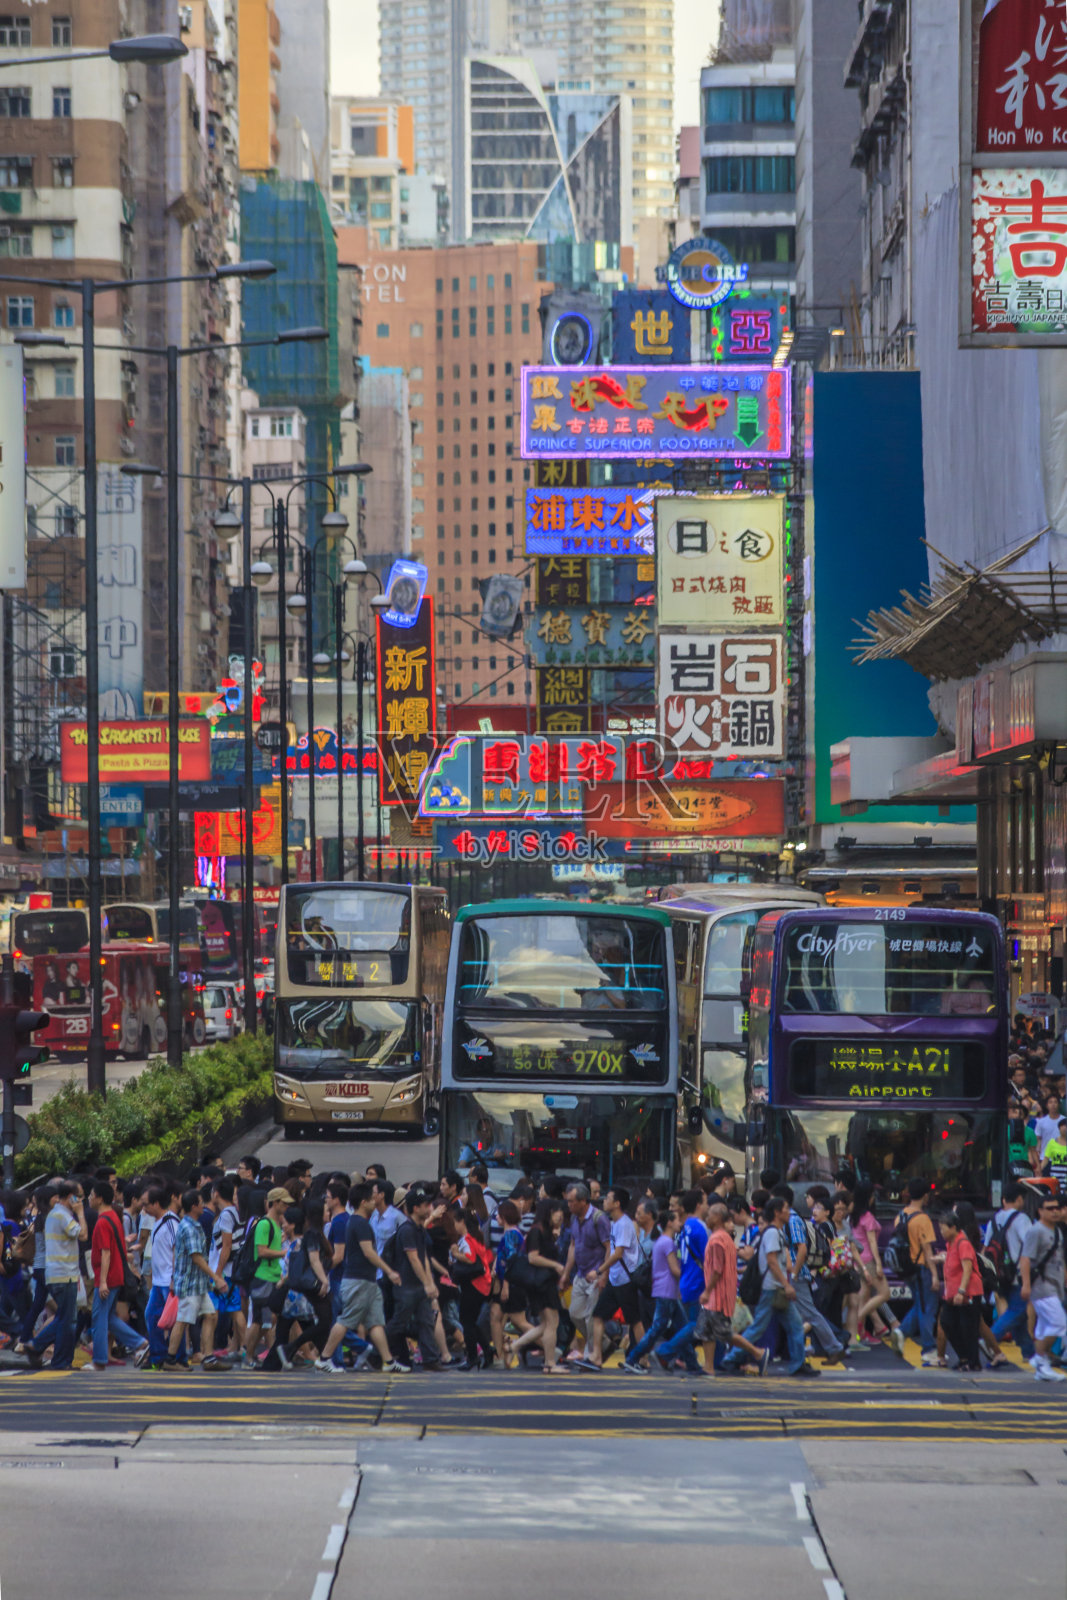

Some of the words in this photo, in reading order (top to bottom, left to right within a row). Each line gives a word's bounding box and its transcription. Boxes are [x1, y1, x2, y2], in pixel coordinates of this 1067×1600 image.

[988, 127, 1016, 145] Hon
[1024, 127, 1043, 145] Wo
[360, 264, 406, 282] TON
[702, 264, 746, 283] GIRL
[362, 285, 405, 303] TEL
[631, 310, 673, 355] 世
[730, 310, 772, 354] 亞
[566, 416, 655, 434] 古法正宗
[530, 437, 577, 451] PRINCE
[659, 437, 736, 451] FOOTBATH
[529, 494, 654, 531] 浦東水
[70, 728, 89, 745] TH
[99, 727, 162, 745] SPAGHETTI
[102, 757, 130, 768] Pasta
[101, 800, 142, 812] ENTRE
[875, 909, 906, 921] 2149
[370, 961, 379, 980] 2
[66, 1018, 88, 1034] 2B
[514, 1057, 532, 1070] So
[339, 1083, 370, 1096] KMB
